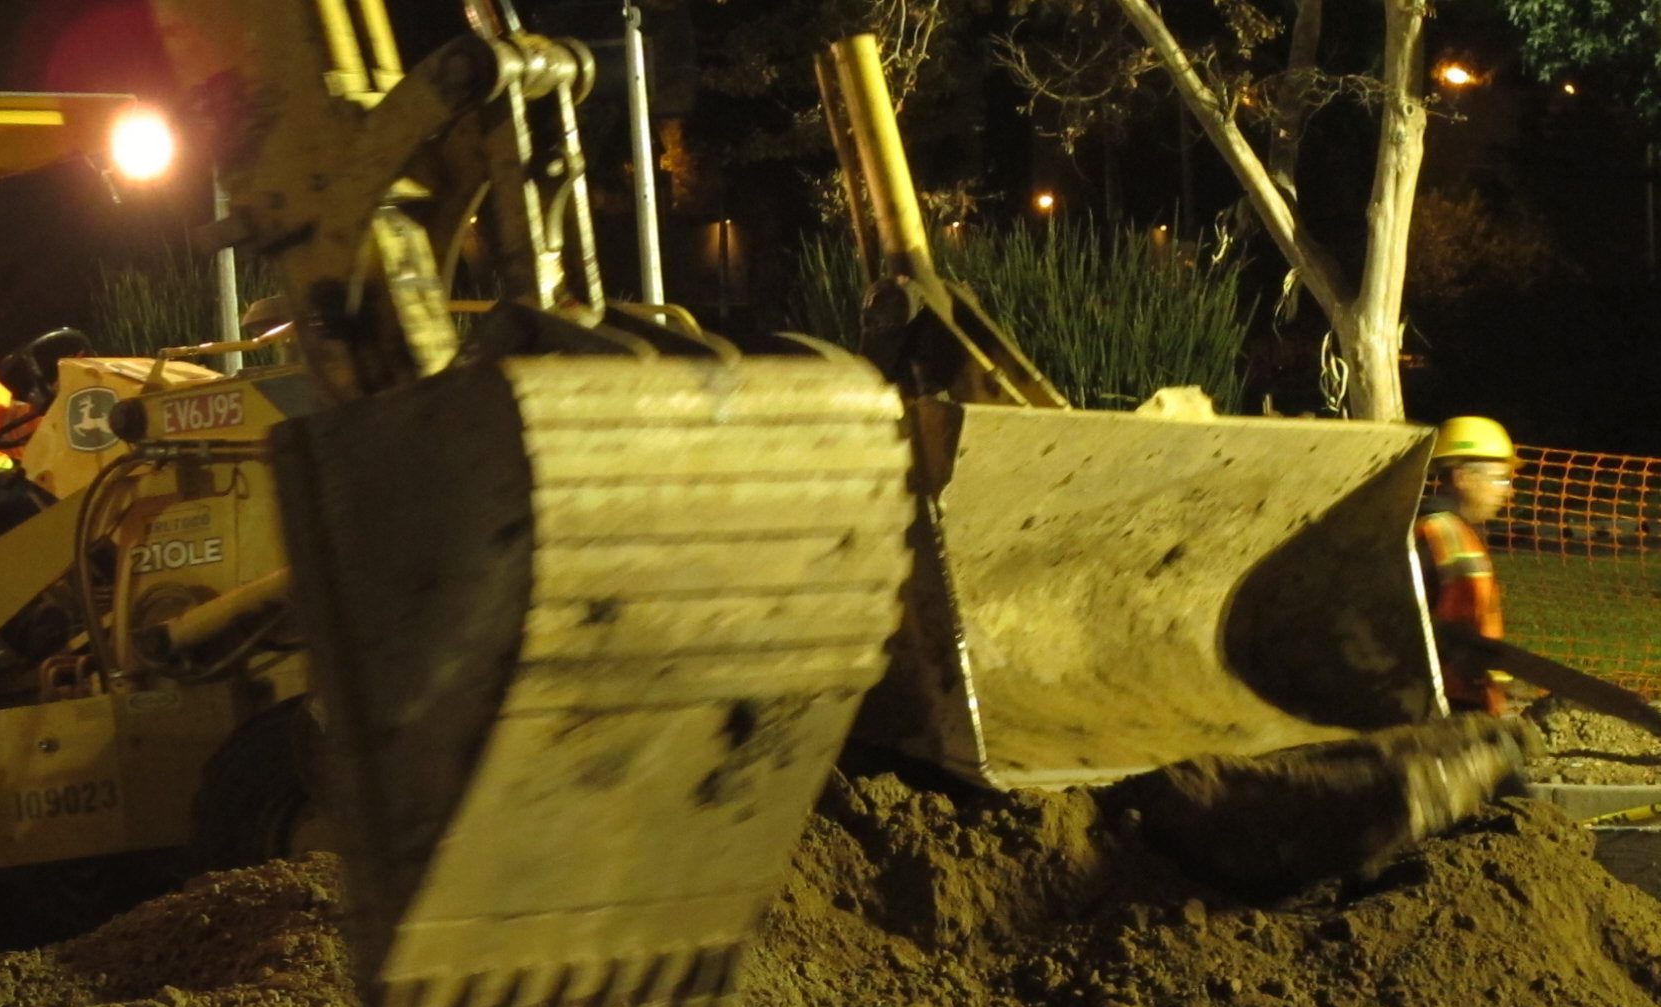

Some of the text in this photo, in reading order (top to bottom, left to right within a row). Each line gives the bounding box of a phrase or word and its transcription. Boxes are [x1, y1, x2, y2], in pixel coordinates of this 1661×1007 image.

[163, 392, 243, 433] EV6J95
[131, 538, 223, 574] 210LE
[14, 779, 118, 821] 109023
